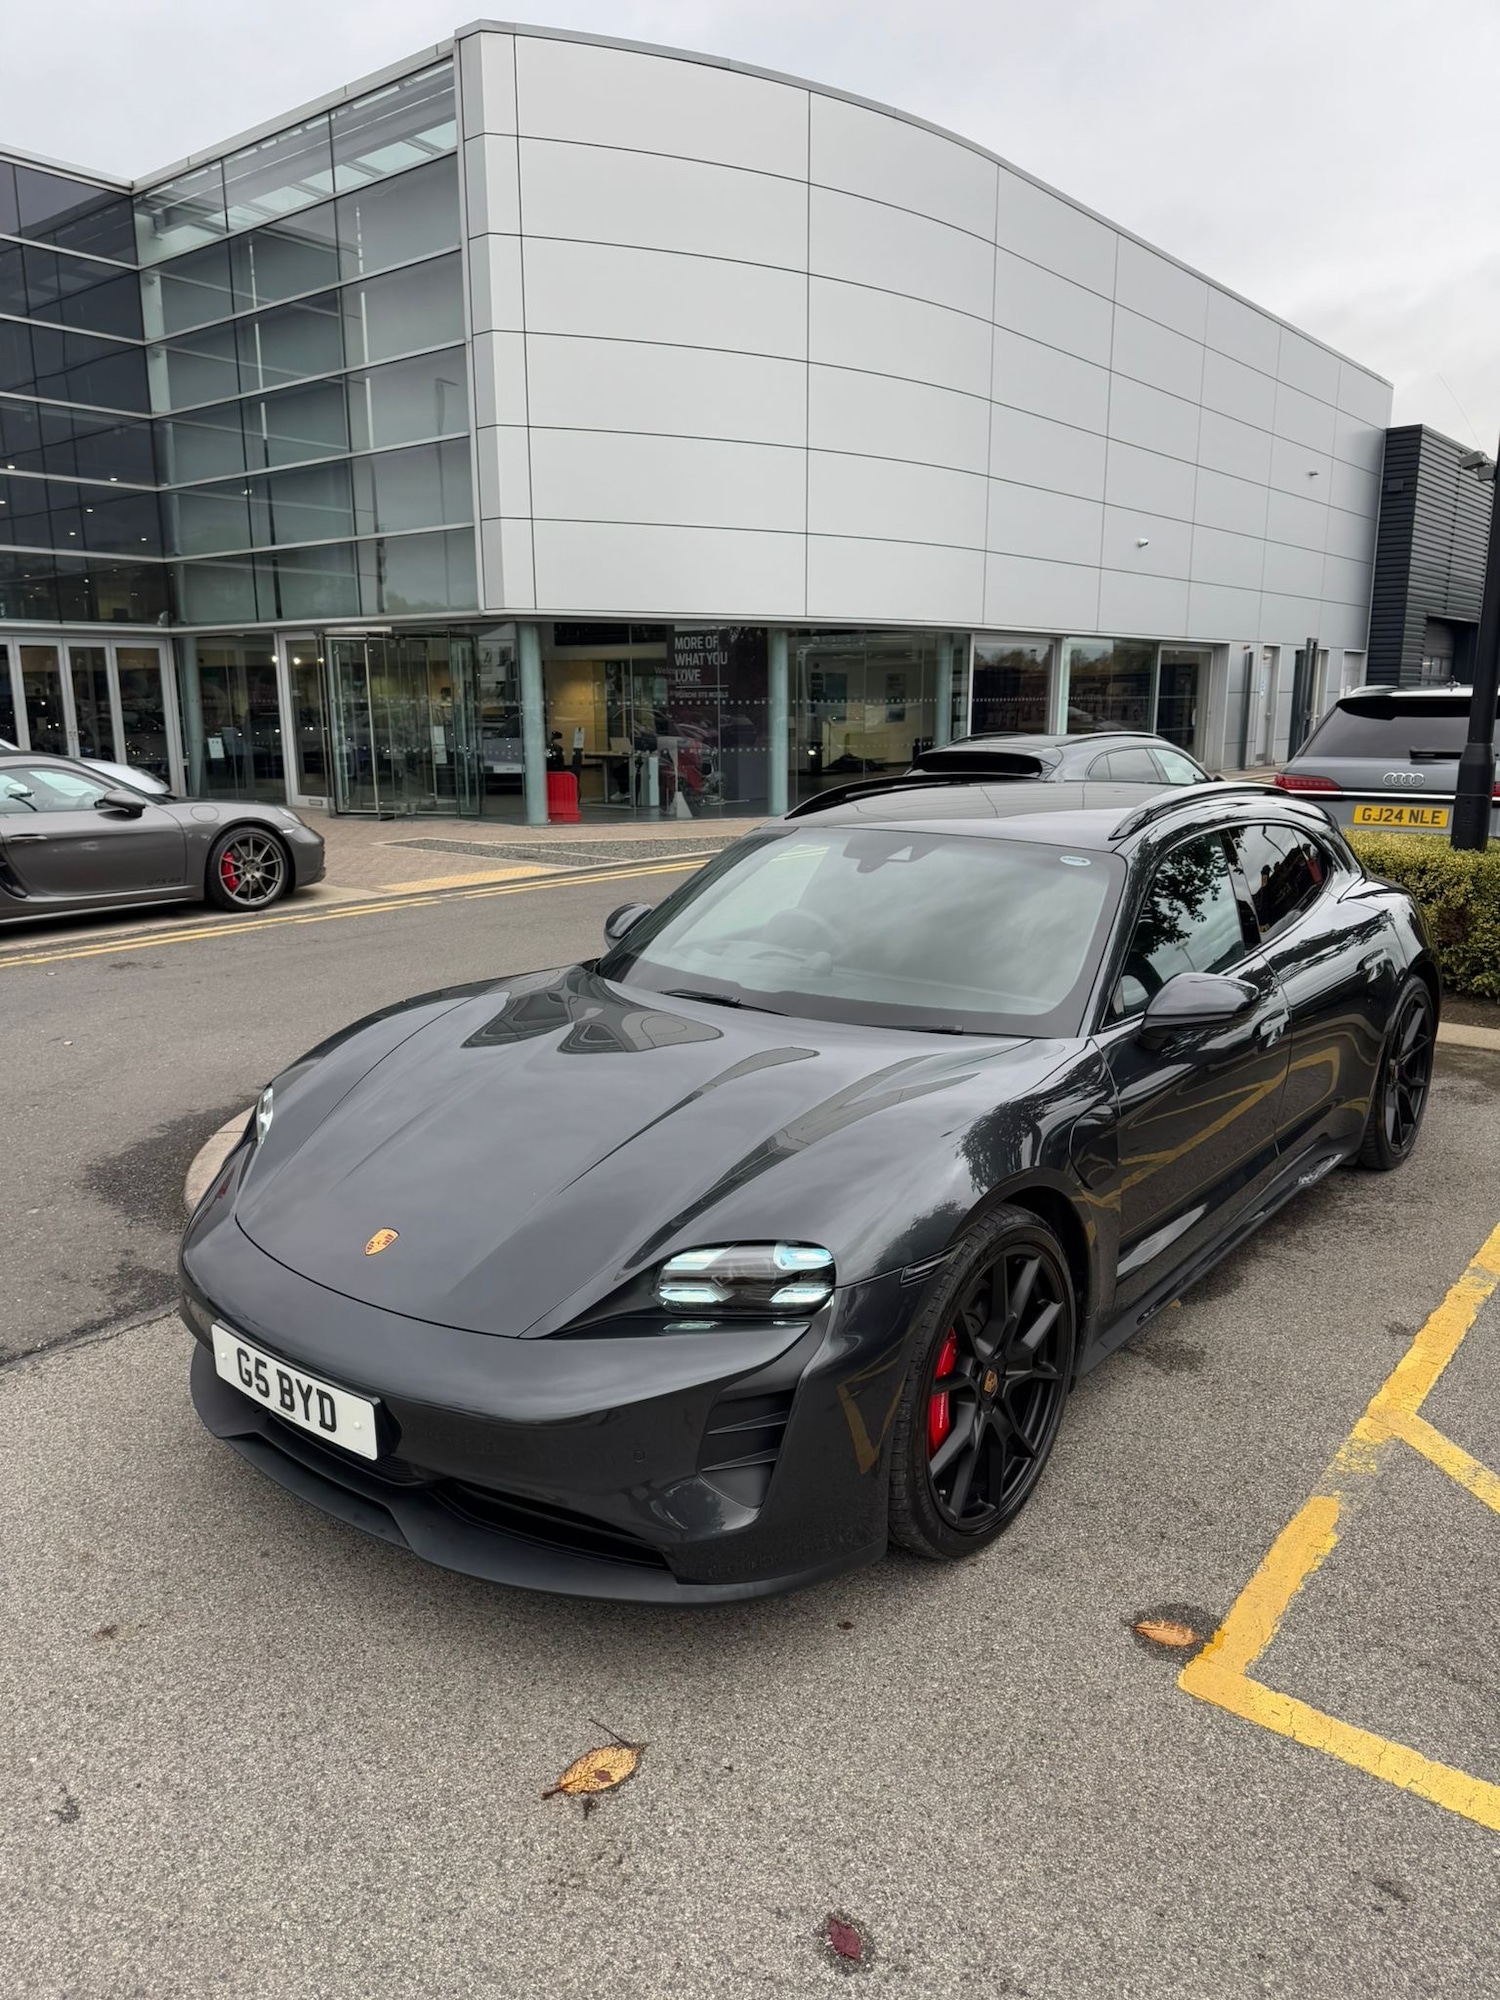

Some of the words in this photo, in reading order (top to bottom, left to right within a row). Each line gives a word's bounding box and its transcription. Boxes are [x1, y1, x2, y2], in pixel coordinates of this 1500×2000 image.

[674, 636, 704, 650] MORE
[705, 635, 719, 649] OF
[674, 652, 705, 666] WHAT
[706, 651, 728, 665] YOU
[675, 668, 701, 682] LOVE
[1362, 807, 1404, 823] GJ24
[1408, 809, 1442, 825] NLE
[237, 1347, 270, 1398] G5
[276, 1368, 337, 1433] BYD
